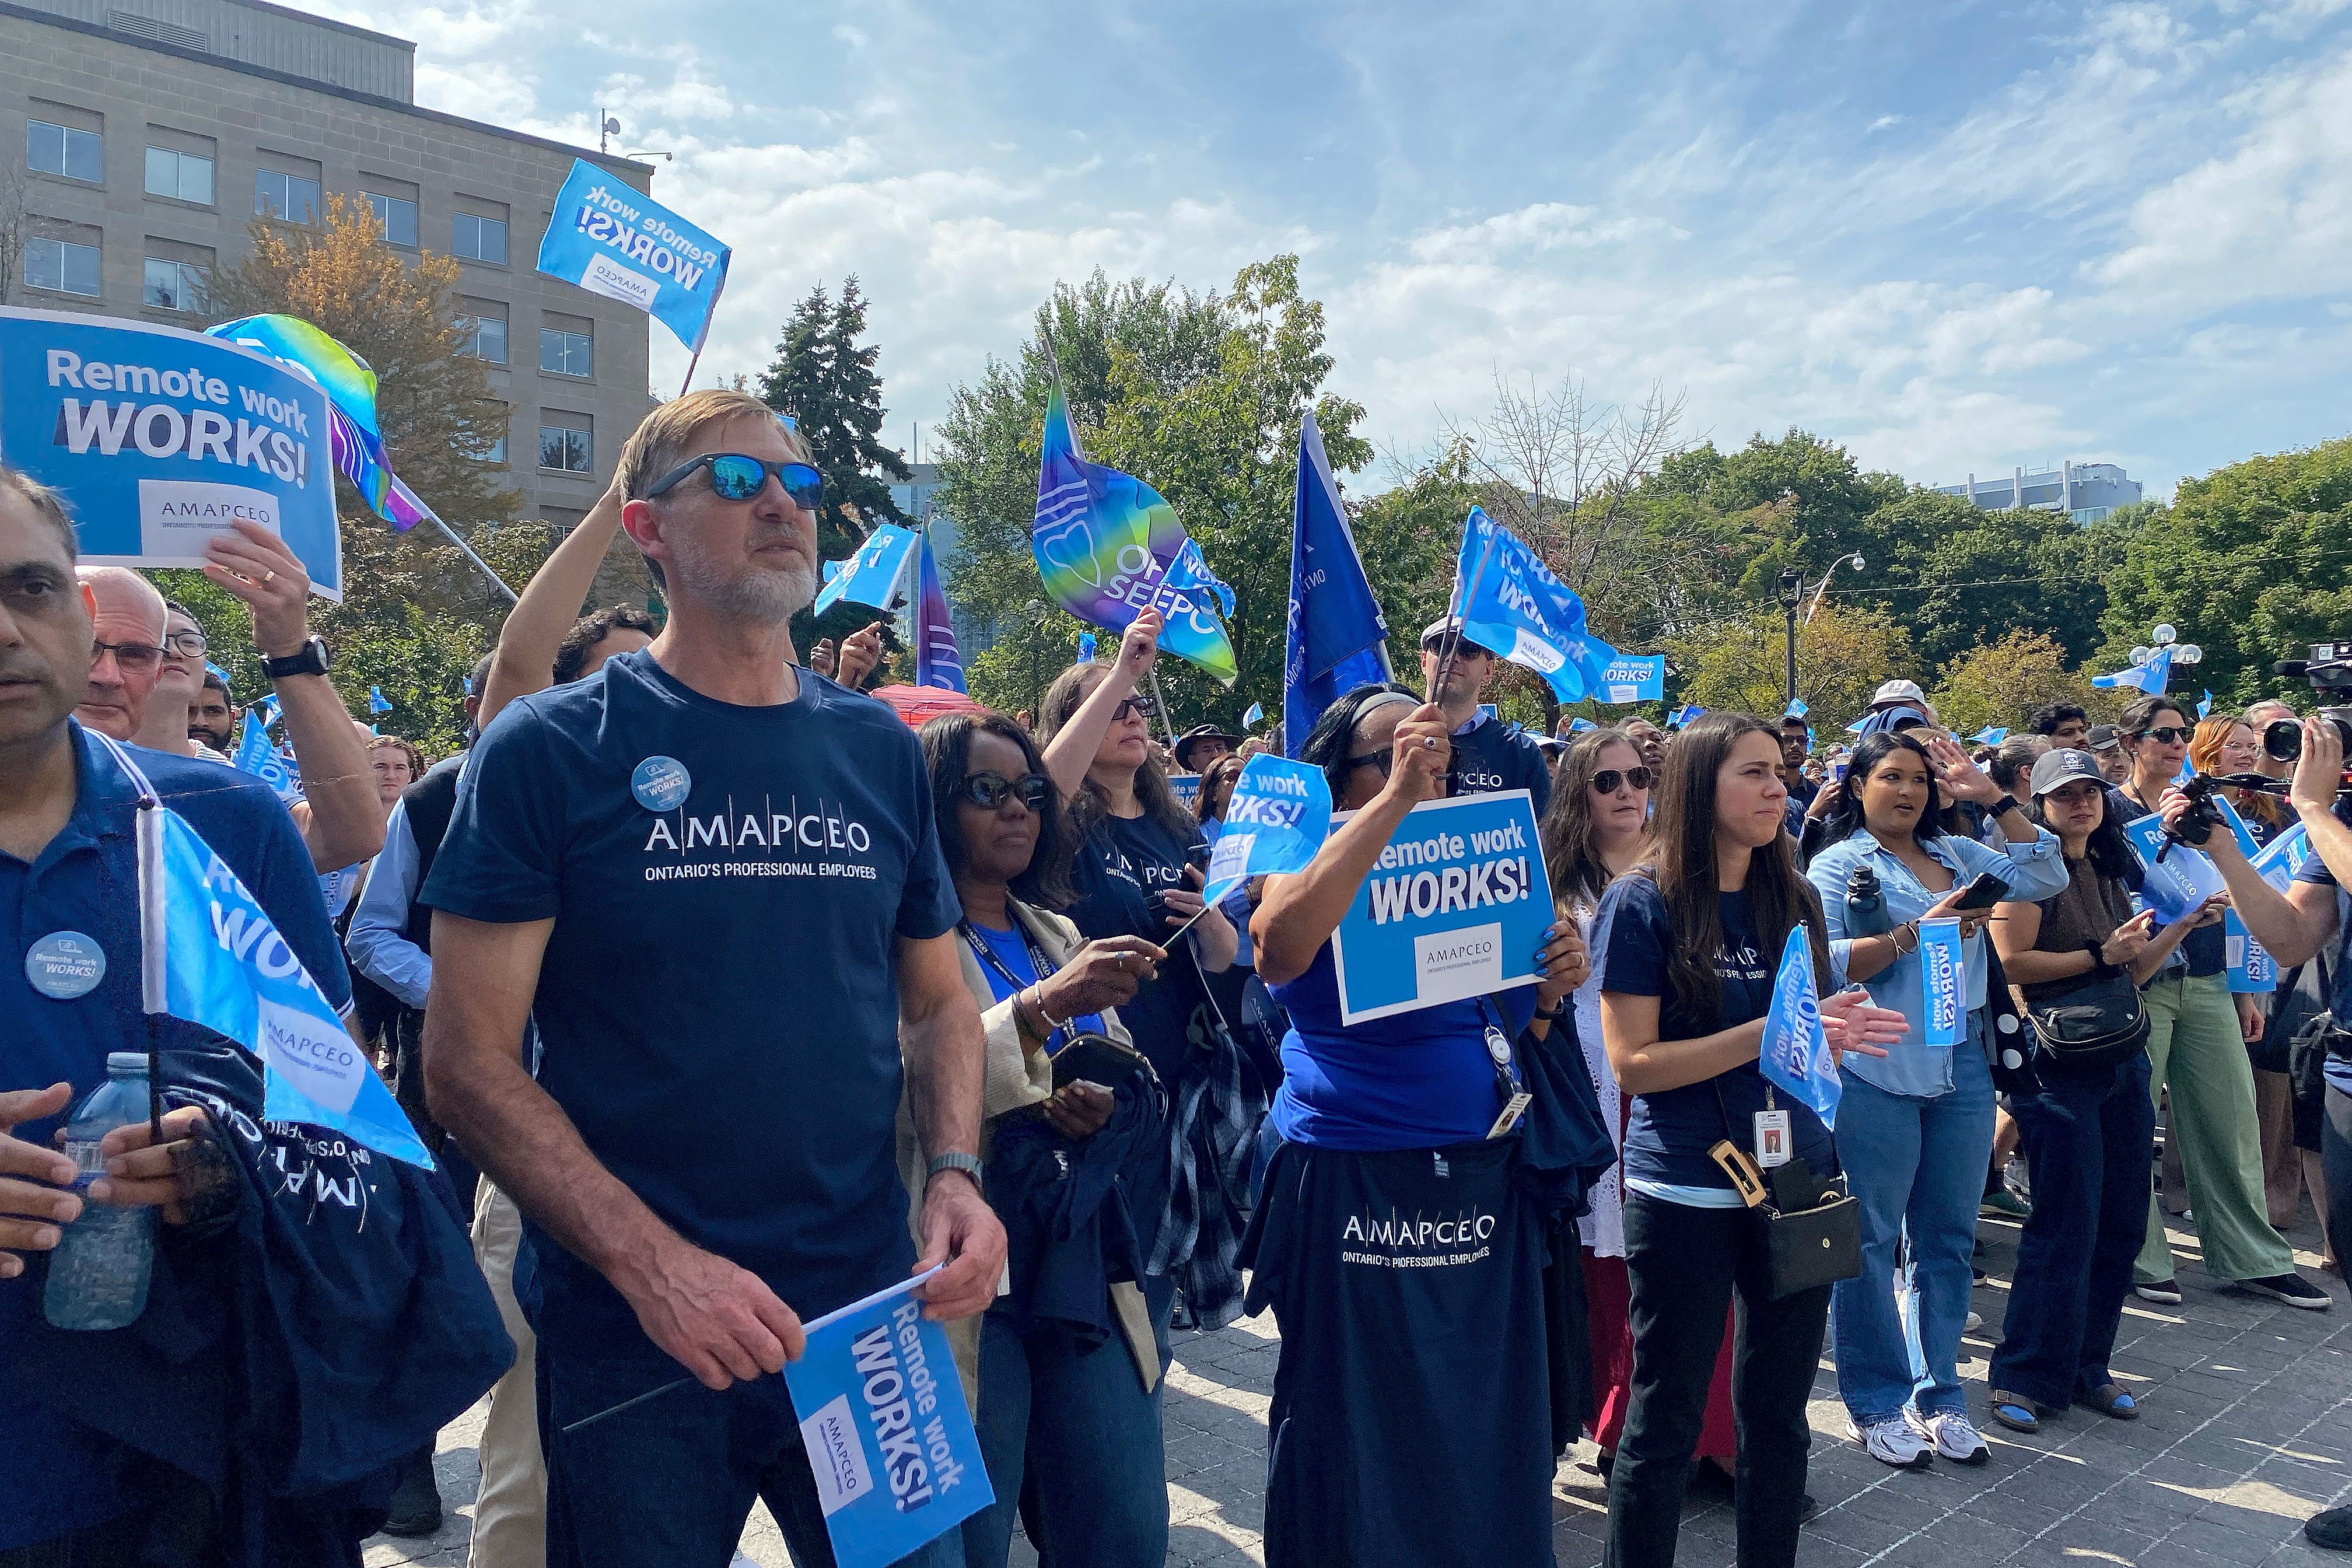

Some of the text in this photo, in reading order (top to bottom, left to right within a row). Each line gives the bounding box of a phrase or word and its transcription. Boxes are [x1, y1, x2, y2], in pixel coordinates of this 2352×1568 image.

[47, 349, 310, 438] Remote work
[62, 398, 306, 489] WORKS!
[161, 502, 270, 523] AMAPCEO
[1631, 661, 1654, 670] work
[1256, 773, 1309, 798] work
[1223, 793, 1304, 830] RKS!
[643, 814, 870, 852] AMAPCEO
[1469, 818, 1527, 855] work
[645, 862, 876, 881] ONTARIO'S PROFESSIONAL EMPLOYEES
[2164, 859, 2197, 896] AMAPCEO
[1371, 855, 1528, 926] WORKS!
[46, 963, 97, 977] WORKS!
[1427, 942, 1492, 964] AMAPCEO
[2262, 957, 2272, 982] work
[1342, 1213, 1495, 1246] AMAPCEO
[1342, 1251, 1390, 1266] ONTARIO'S
[892, 1300, 967, 1496] Remote work
[852, 1324, 935, 1511] WORKS!
[827, 1416, 857, 1489] AMAPCEO
